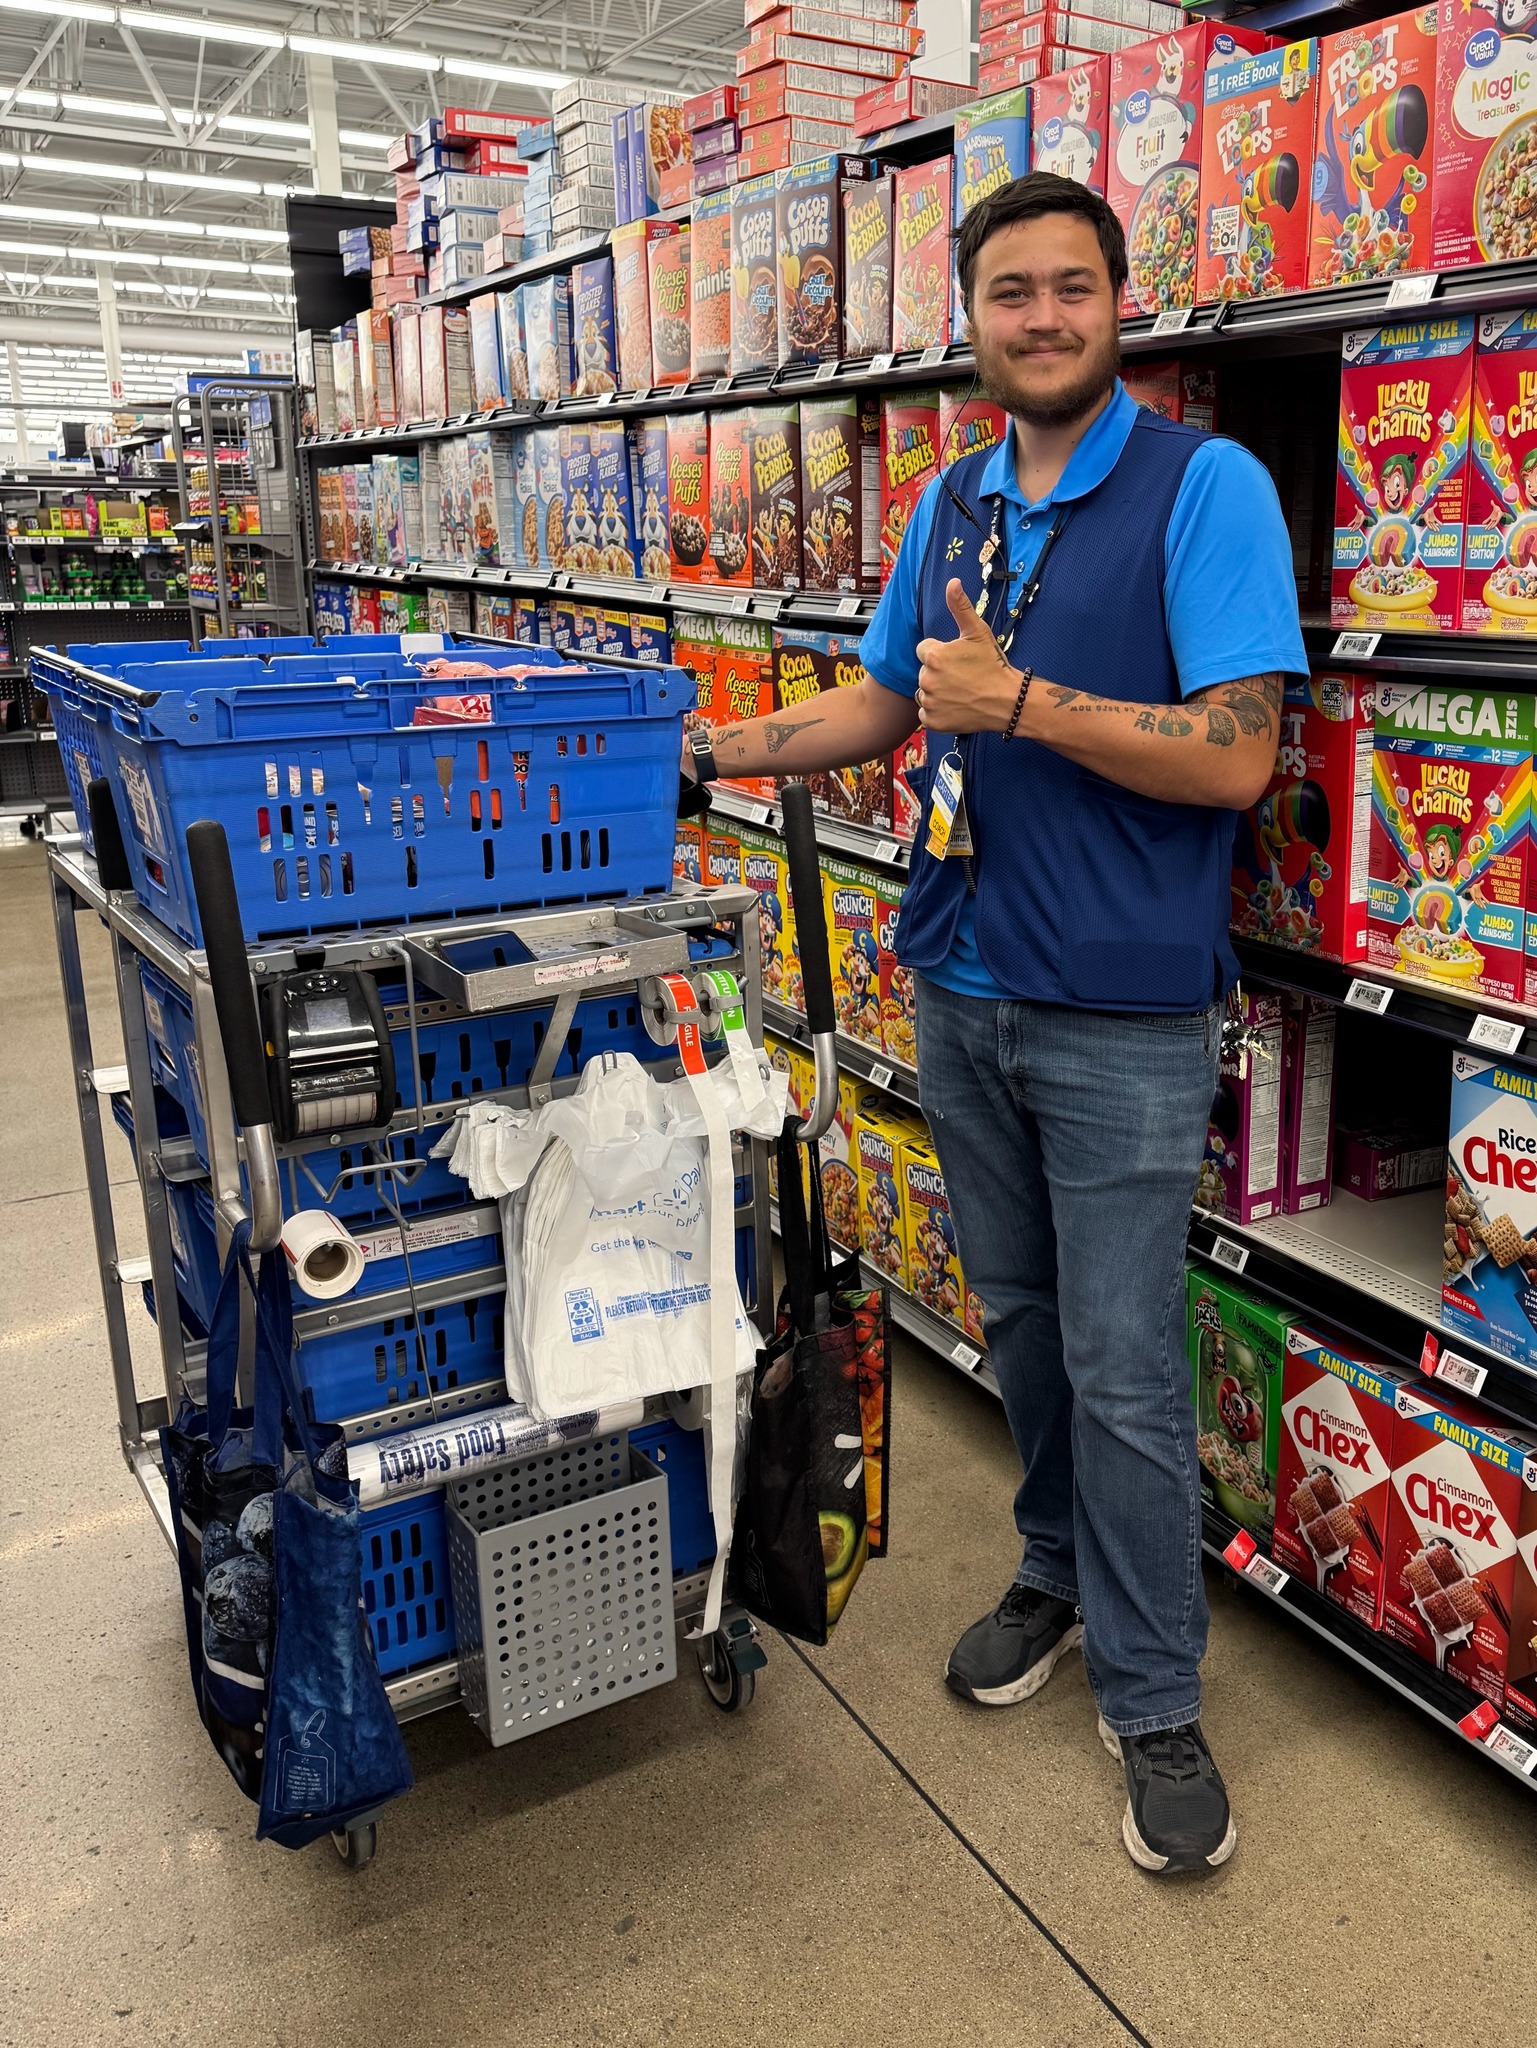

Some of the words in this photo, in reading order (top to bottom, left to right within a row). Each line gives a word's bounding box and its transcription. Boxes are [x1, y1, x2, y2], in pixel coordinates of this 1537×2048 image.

[1445, 6, 1452, 22] 8
[1216, 38, 1232, 47] Great
[1469, 36, 1494, 56] Great
[1328, 24, 1399, 96] FROOT
[1474, 50, 1494, 62] Value
[1112, 60, 1123, 76] 15
[1220, 78, 1224, 92] 1
[1226, 70, 1250, 91] FREE
[1252, 61, 1280, 82] BOOK
[1334, 58, 1398, 118] LOOPS
[1472, 70, 1530, 103] Magic
[972, 105, 994, 122] FAMILY
[996, 100, 1010, 113] SIZE
[1128, 96, 1147, 112] Great
[1131, 105, 1148, 118] Value
[1478, 102, 1520, 122] Treasures
[1044, 124, 1060, 138] Great
[1216, 99, 1272, 156] FROOT
[1136, 129, 1166, 158] Fruit
[1222, 126, 1272, 175] LOOPS
[792, 162, 814, 179] FAMILY
[815, 157, 830, 172] SIZE
[964, 144, 1005, 182] FRUITY
[900, 182, 938, 218] FRUITY
[900, 200, 943, 257] PEBBLES
[850, 214, 888, 266] PEBBLES
[653, 263, 688, 291] Reese's
[694, 262, 731, 301] minis
[578, 285, 602, 305] FROSTED
[658, 286, 686, 314] Puffs
[580, 296, 601, 316] FLAKES
[1380, 324, 1428, 347] FAMILY
[1430, 320, 1458, 340] SIZE
[1378, 379, 1430, 417] Lucky
[888, 424, 928, 454] FRUITY
[950, 417, 992, 450] FRUITY
[1368, 410, 1433, 448] Charms
[755, 430, 787, 460] COCOA
[807, 424, 843, 458] COCOA
[567, 453, 590, 470] FROSTED
[598, 452, 618, 470] FROSTED
[716, 442, 742, 462] Reese's
[568, 464, 588, 480] FLAKES
[599, 463, 618, 480] FLAKES
[670, 452, 702, 479] Reese's
[718, 462, 740, 484] Puffs
[754, 450, 793, 495] PEBBLES
[806, 444, 850, 494] PEBBLES
[886, 440, 936, 492] PEBBLES
[674, 479, 701, 506] Puffs
[1334, 536, 1363, 549] LIMITED
[1425, 534, 1458, 548] JUMBO
[1468, 535, 1500, 548] LIMITED
[1336, 549, 1360, 560] EDITION
[1423, 548, 1458, 559] RAINBOWS!
[1470, 549, 1495, 560] EDITION
[604, 611, 616, 620] FAMILY
[617, 613, 627, 622] SIZE
[640, 616, 653, 625] FAMILY
[654, 618, 664, 626] SIZE
[680, 616, 716, 642] MEGA
[722, 620, 761, 648] MEGA
[787, 632, 802, 642] MEGA
[803, 632, 816, 642] SIZE
[602, 642, 623, 655] FROSTED
[638, 648, 659, 660] FROSTED
[780, 654, 814, 680] COCOA
[726, 668, 760, 696] Reese's
[730, 694, 758, 718] Puffs
[1394, 692, 1502, 738] MEGA
[1505, 699, 1518, 740] SIZE
[1492, 750, 1500, 762] 12
[1421, 763, 1470, 798] Lucky
[937, 778, 954, 810] CARTER
[1412, 789, 1473, 824] Charms
[706, 816, 728, 832] FAMILY
[932, 818, 946, 838] COACH
[740, 831, 766, 846] FAMILY
[766, 839, 780, 851] SIZE
[708, 855, 740, 880] CRUNCH
[744, 856, 778, 880] CRUNCH
[828, 861, 858, 880] FAMILY
[833, 891, 874, 918] CRUNCH
[1368, 886, 1399, 904] LIMITED
[1370, 900, 1394, 914] EDITION
[835, 912, 872, 932] BERRIES
[1480, 914, 1514, 932] JUMBO
[859, 932, 866, 947] C
[1478, 926, 1514, 941] RAINBOWS!
[1503, 982, 1514, 990] NETO
[858, 1131, 893, 1164] CRUNCH
[1498, 1128, 1536, 1154] Rice
[882, 1176, 888, 1190] C
[934, 1211, 942, 1226] C
[406, 1232, 422, 1240] CLEAR
[592, 1242, 612, 1252] Get
[614, 1238, 630, 1249] the
[606, 1304, 626, 1318] PLEASE
[626, 1299, 648, 1312] RETURN
[676, 1294, 688, 1306] STORE
[688, 1292, 698, 1304] FOR
[1443, 1290, 1462, 1305] Gluten
[1463, 1300, 1476, 1312] Free
[1194, 1306, 1222, 1332] JACKS
[1444, 1305, 1453, 1316] NO
[574, 1326, 596, 1334] PLASTIC
[1444, 1316, 1453, 1326] NO
[580, 1332, 592, 1340] BAG
[1318, 1350, 1356, 1383] FAMILY
[1358, 1373, 1382, 1398] SIZE
[1320, 1409, 1368, 1439] Cinnamon
[1485, 1428, 1509, 1440] Chex
[454, 1422, 506, 1466] Food
[1294, 1406, 1372, 1474] Chex
[1434, 1415, 1479, 1450] FAMILY
[1480, 1440, 1509, 1468] SIZE
[379, 1438, 451, 1483] Safety
[1437, 1477, 1493, 1511] Cinnamon
[1406, 1472, 1500, 1548] Chex
[1231, 1540, 1248, 1560] Rollback
[1274, 1528, 1290, 1544] Gluten
[1290, 1540, 1302, 1552] Free
[1274, 1542, 1283, 1552] NO
[1274, 1552, 1282, 1562] NO
[1348, 1556, 1374, 1576] Cinnamon
[1355, 1554, 1368, 1566] Real
[1385, 1600, 1404, 1618] Gluten
[1404, 1612, 1417, 1627] Free
[1386, 1616, 1396, 1628] NO
[1386, 1626, 1396, 1637] NO
[1481, 1632, 1495, 1644] Real
[1472, 1634, 1503, 1656] Cinnamon
[1506, 1701, 1516, 1712] NO
[1508, 1688, 1524, 1705] Gluten
[1524, 1700, 1536, 1714] Free
[1506, 1710, 1516, 1720] NO
